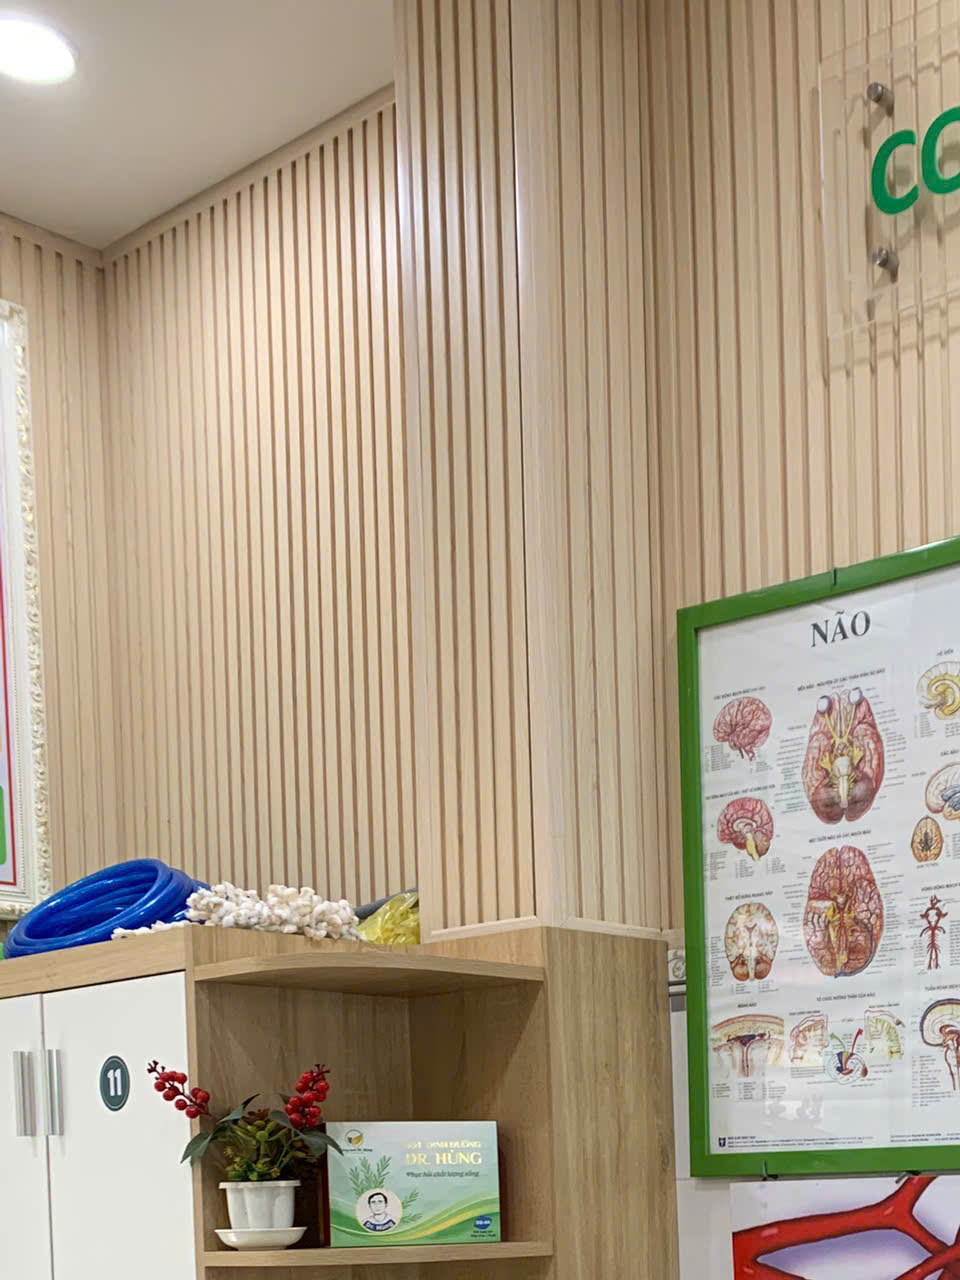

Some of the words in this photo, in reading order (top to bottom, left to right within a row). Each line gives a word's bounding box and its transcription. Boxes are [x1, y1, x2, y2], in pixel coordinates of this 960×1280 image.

[811, 609, 871, 648] NÃO
[107, 1068, 122, 1096] 11
[435, 1149, 482, 1165] HÙNG
